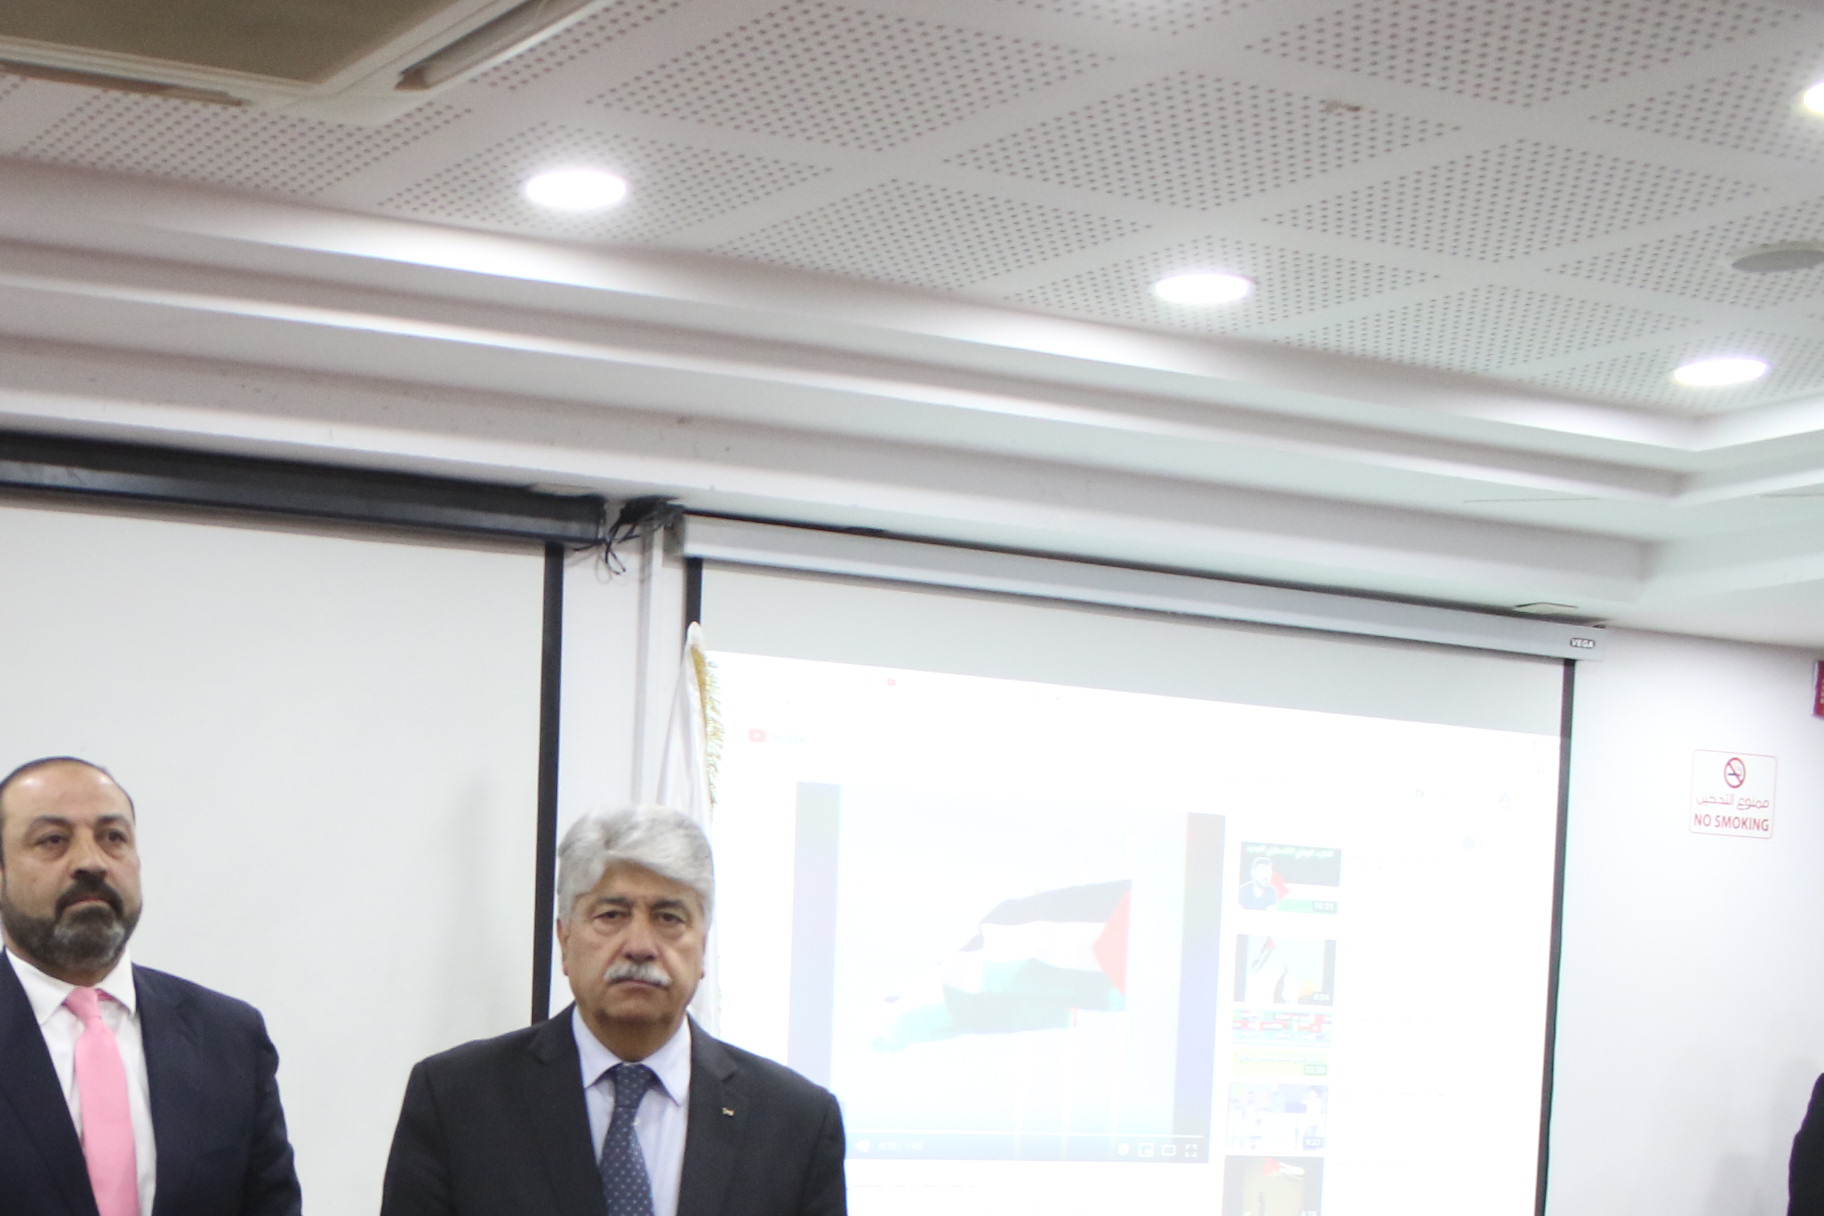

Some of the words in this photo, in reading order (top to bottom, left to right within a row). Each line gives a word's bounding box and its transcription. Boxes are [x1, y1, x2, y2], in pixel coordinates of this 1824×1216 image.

[1571, 639, 1594, 649] VEGA
[1693, 813, 1712, 827] NO
[1714, 815, 1770, 832] SMOKING
